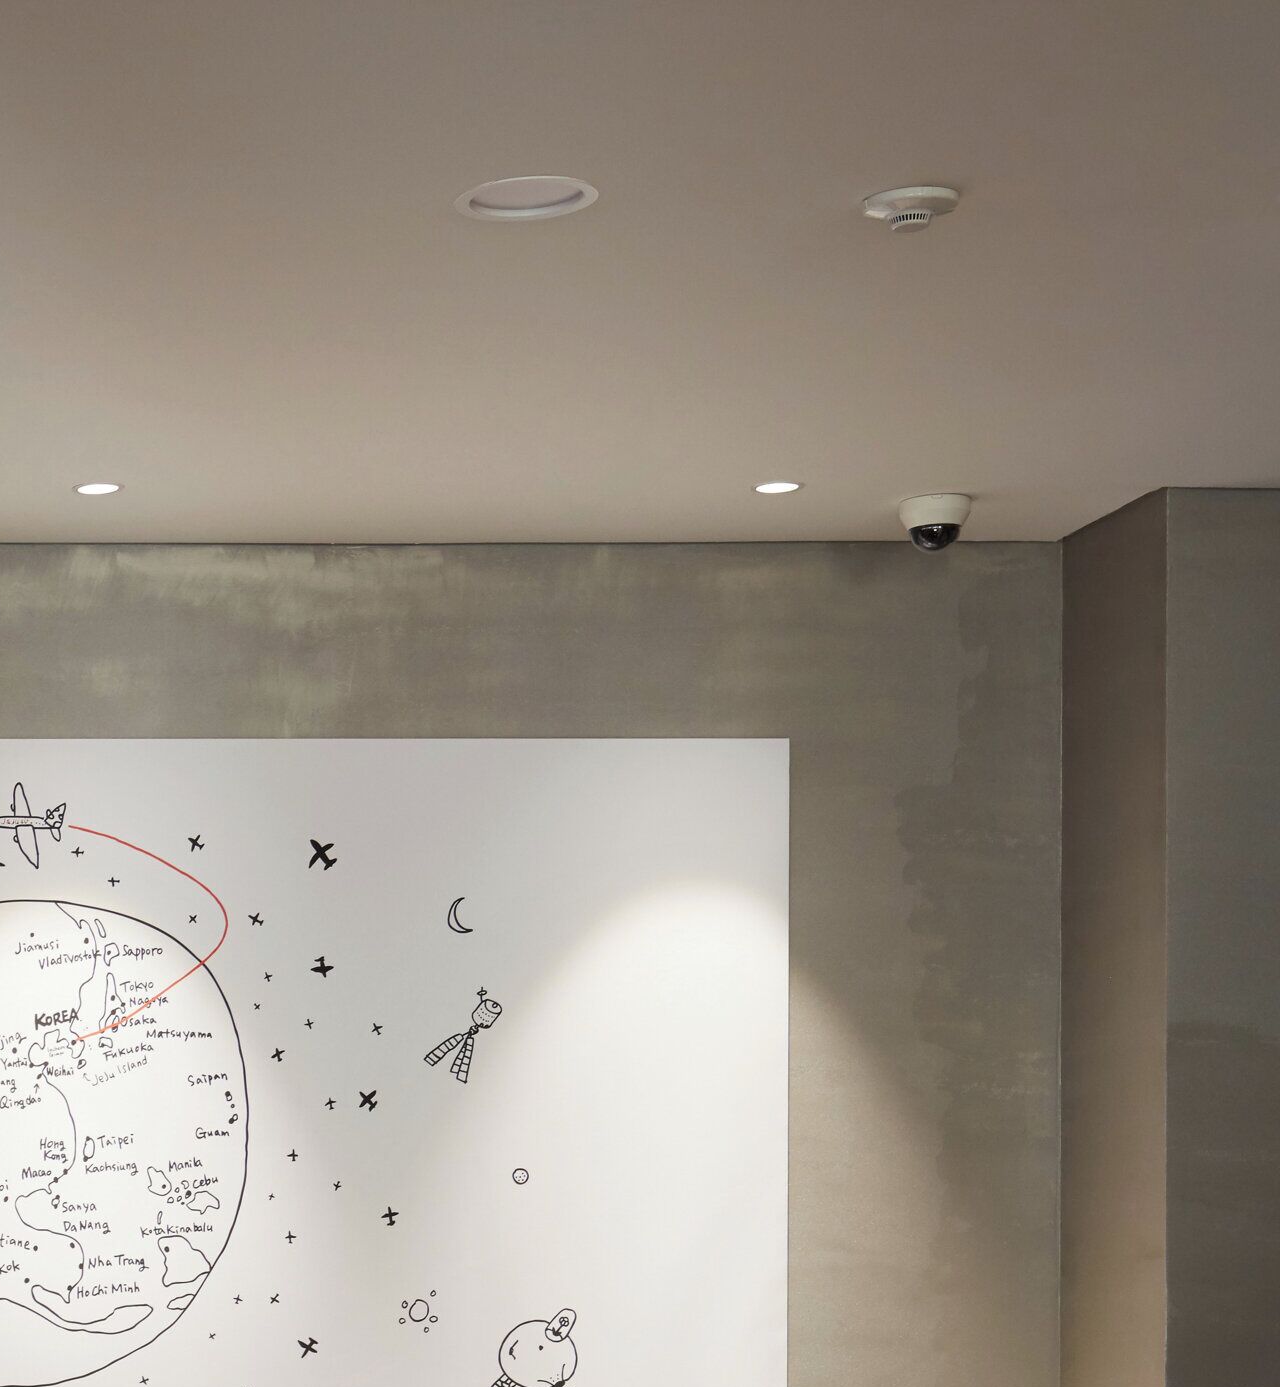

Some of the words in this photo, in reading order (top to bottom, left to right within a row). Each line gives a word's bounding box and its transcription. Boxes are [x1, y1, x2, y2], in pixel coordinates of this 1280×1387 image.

[15, 939, 60, 955] Jiamusi
[122, 945, 163, 958] Sapporo
[39, 949, 101, 969] Vladivostok
[120, 980, 154, 993] Tokyo
[129, 995, 169, 1007] Nagoya
[34, 1008, 80, 1030] KOREA
[121, 1015, 157, 1026] Osaka
[146, 1028, 213, 1039] Matsuyama
[103, 1043, 155, 1061] Fukuoka
[0, 1057, 29, 1069] Yantai
[46, 1065, 75, 1078] Weihai
[187, 1072, 228, 1085] Saipan
[0, 1095, 42, 1109] Qingdao
[195, 1127, 230, 1140] Guam
[39, 1137, 66, 1150] Hong
[97, 1133, 135, 1149] Taipei
[43, 1150, 68, 1163] Kong
[84, 1160, 139, 1176] Kaohsiung
[168, 1158, 203, 1172] Manila
[21, 1167, 52, 1180] Macao
[61, 1201, 97, 1213] Sanya
[88, 1258, 112, 1269] Nha
[114, 1254, 149, 1272] Trang
[111, 1282, 140, 1293] Minh
